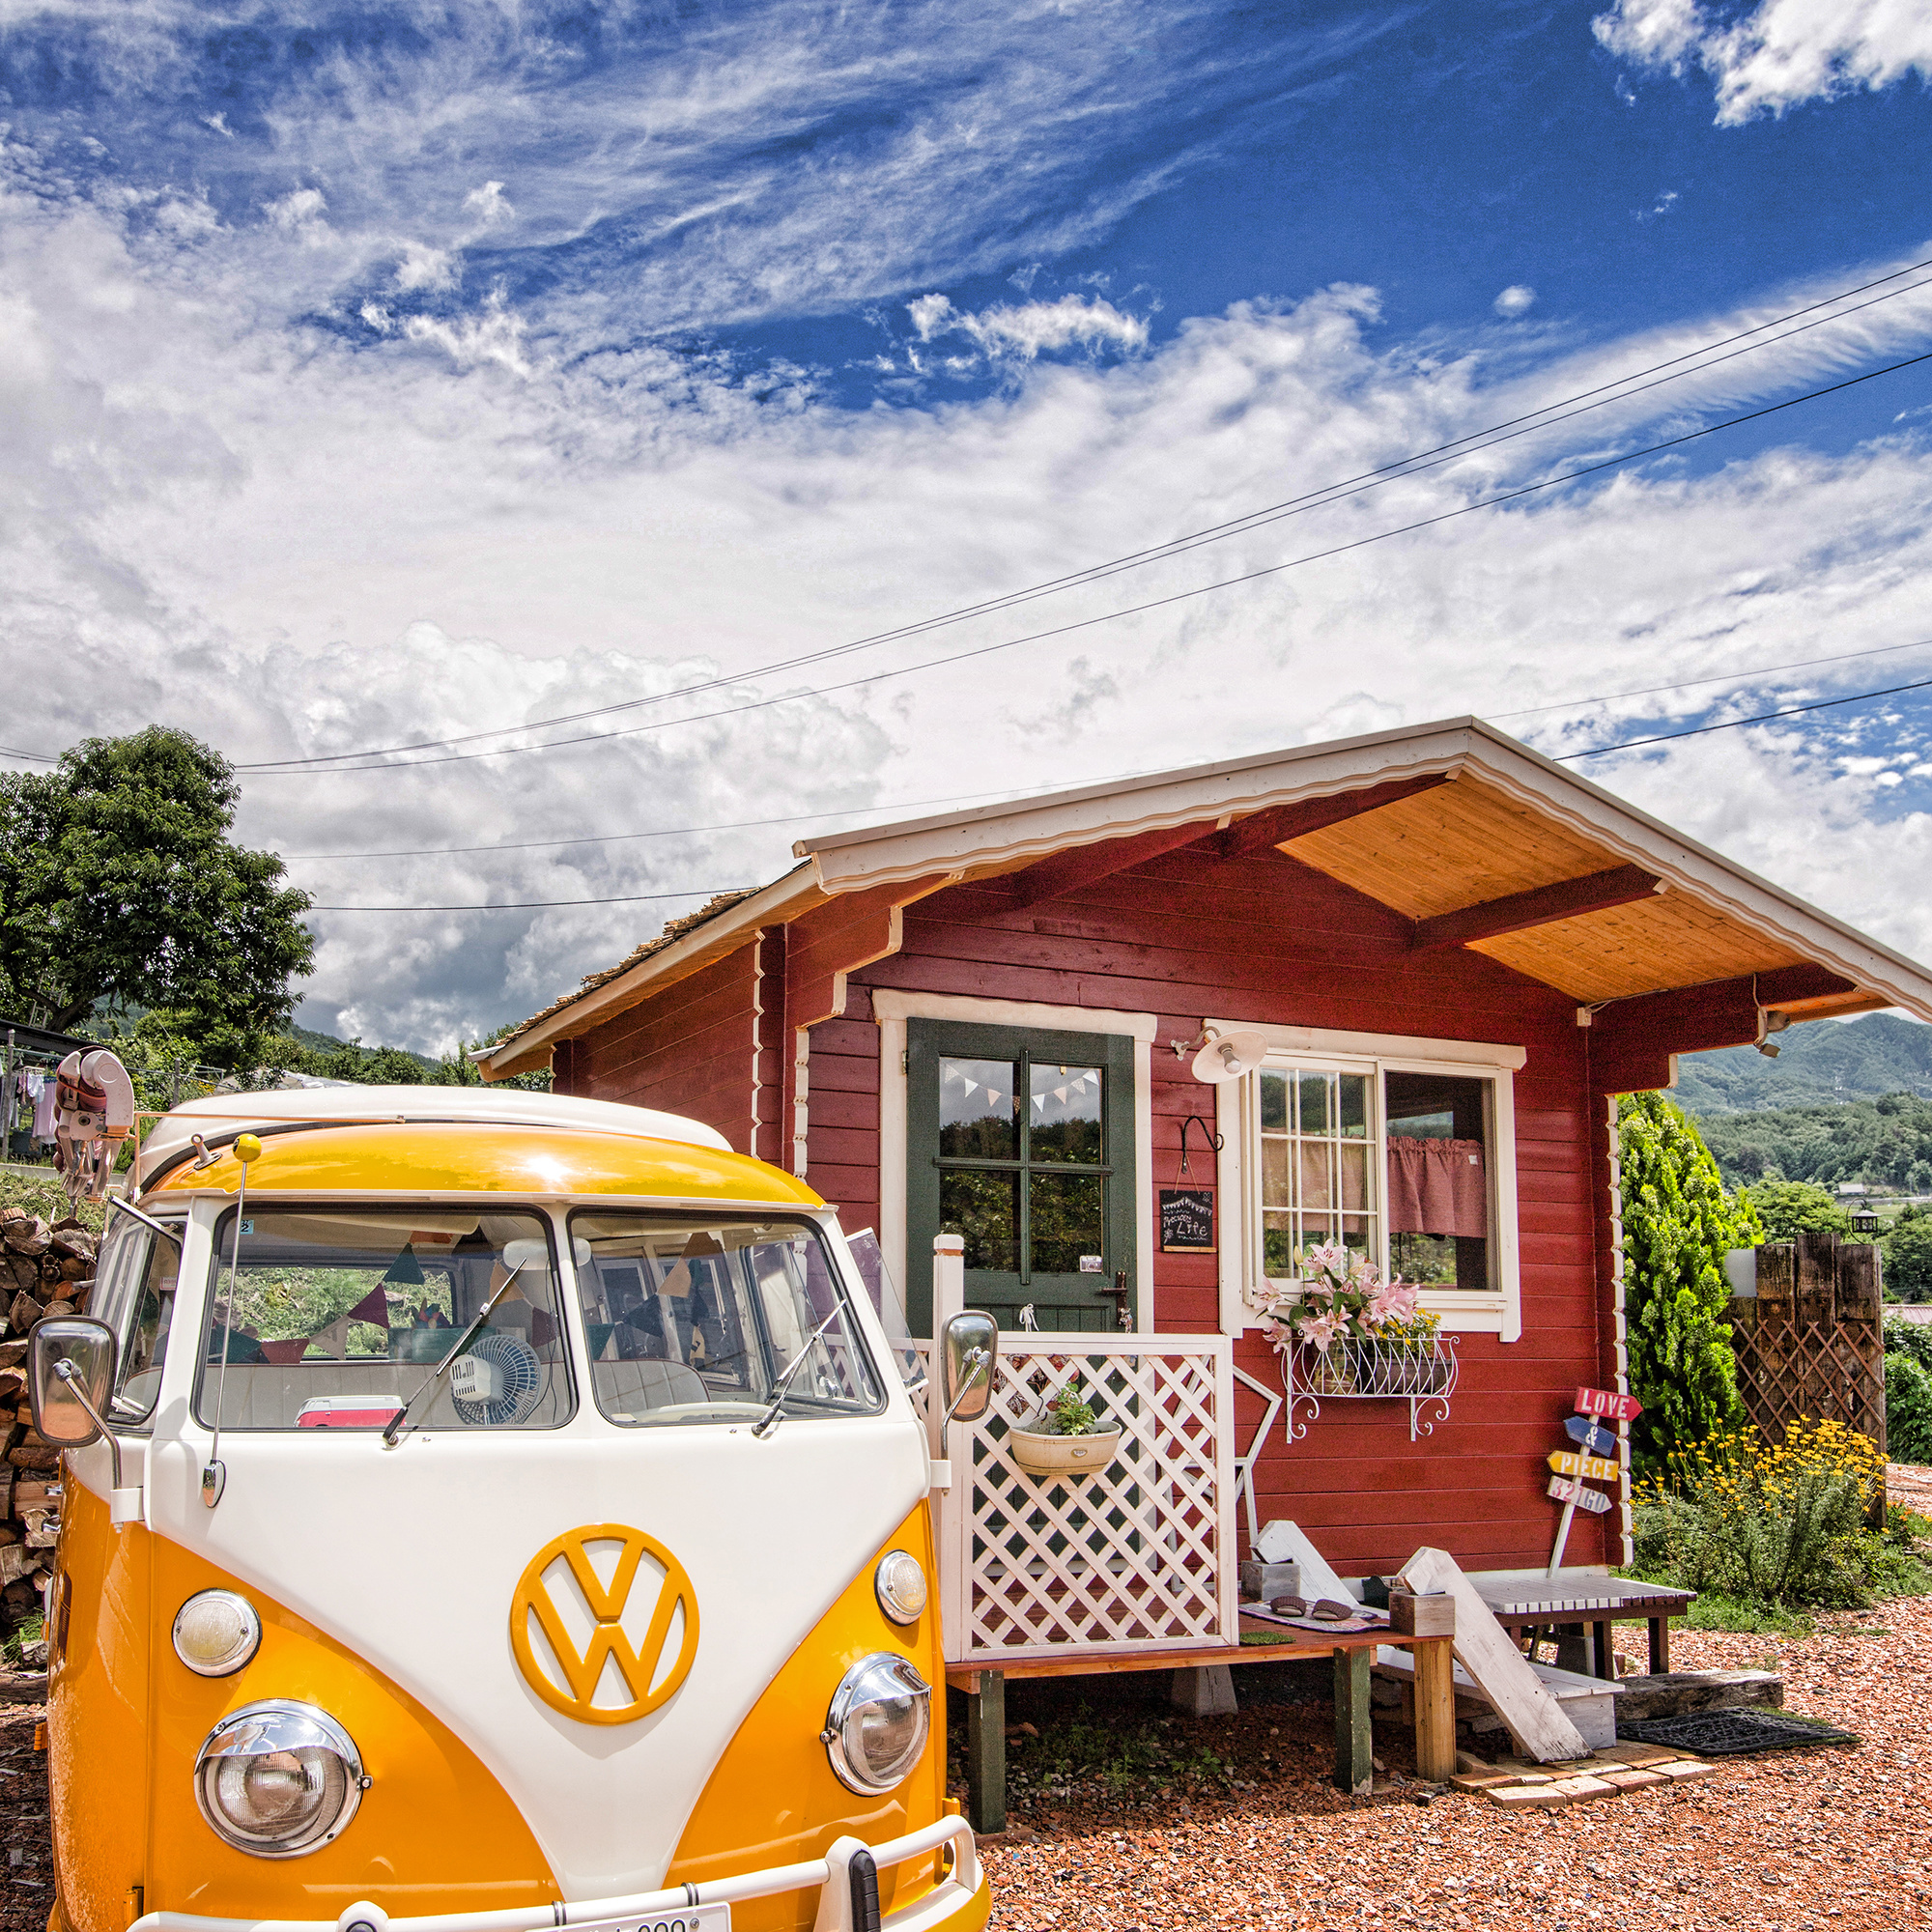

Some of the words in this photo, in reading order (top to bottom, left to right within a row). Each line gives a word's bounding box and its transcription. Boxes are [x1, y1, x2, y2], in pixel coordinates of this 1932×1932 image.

[1177, 1221, 1208, 1236] Life
[1581, 1389, 1630, 1418] LOVE
[1585, 1426, 1599, 1447] &
[1560, 1454, 1614, 1481] PIECE
[515, 1527, 696, 1721] VW
